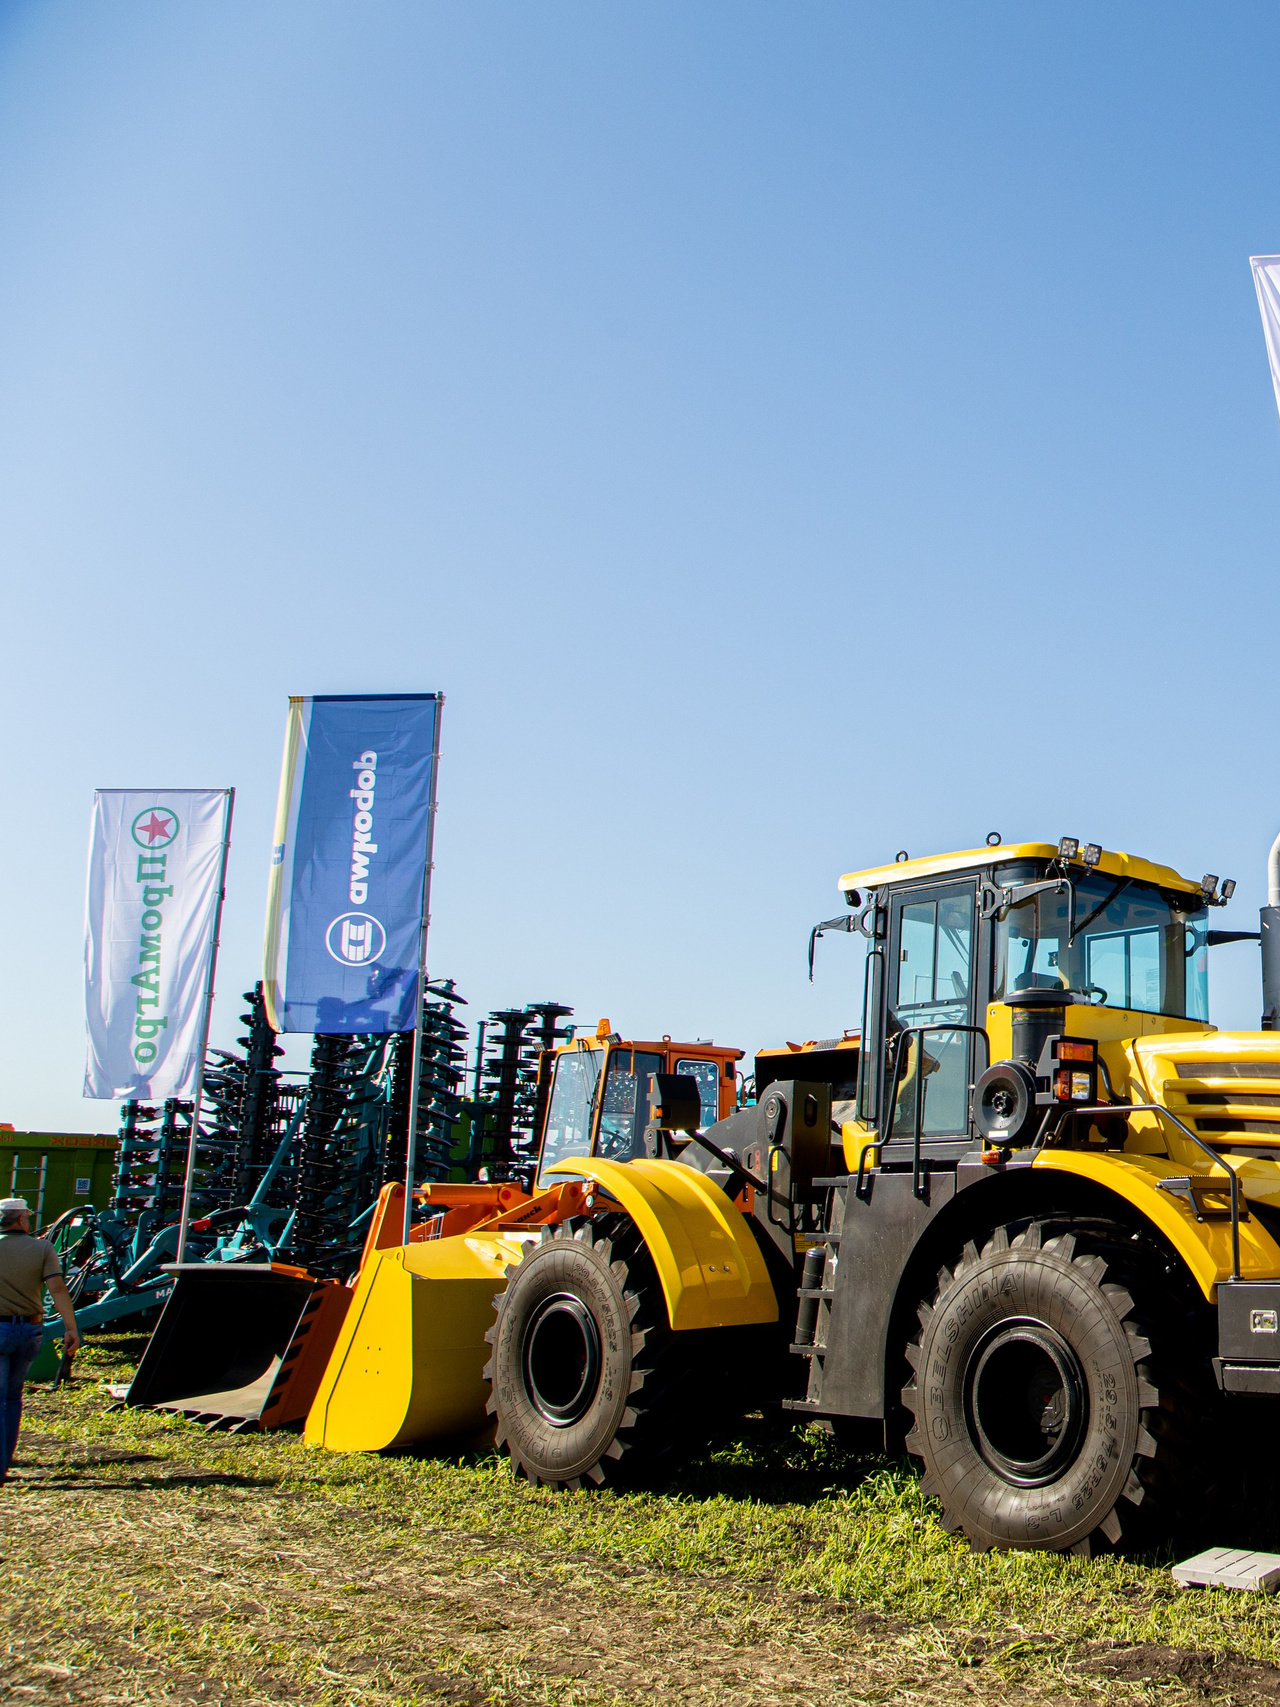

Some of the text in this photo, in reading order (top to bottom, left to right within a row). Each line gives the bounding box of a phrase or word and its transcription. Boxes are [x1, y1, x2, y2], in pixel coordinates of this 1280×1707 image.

[930, 1273, 1018, 1411] BELSHINA
[1074, 1373, 1118, 1510] 29.5/75R25
[1027, 1507, 1063, 1530] L-3
